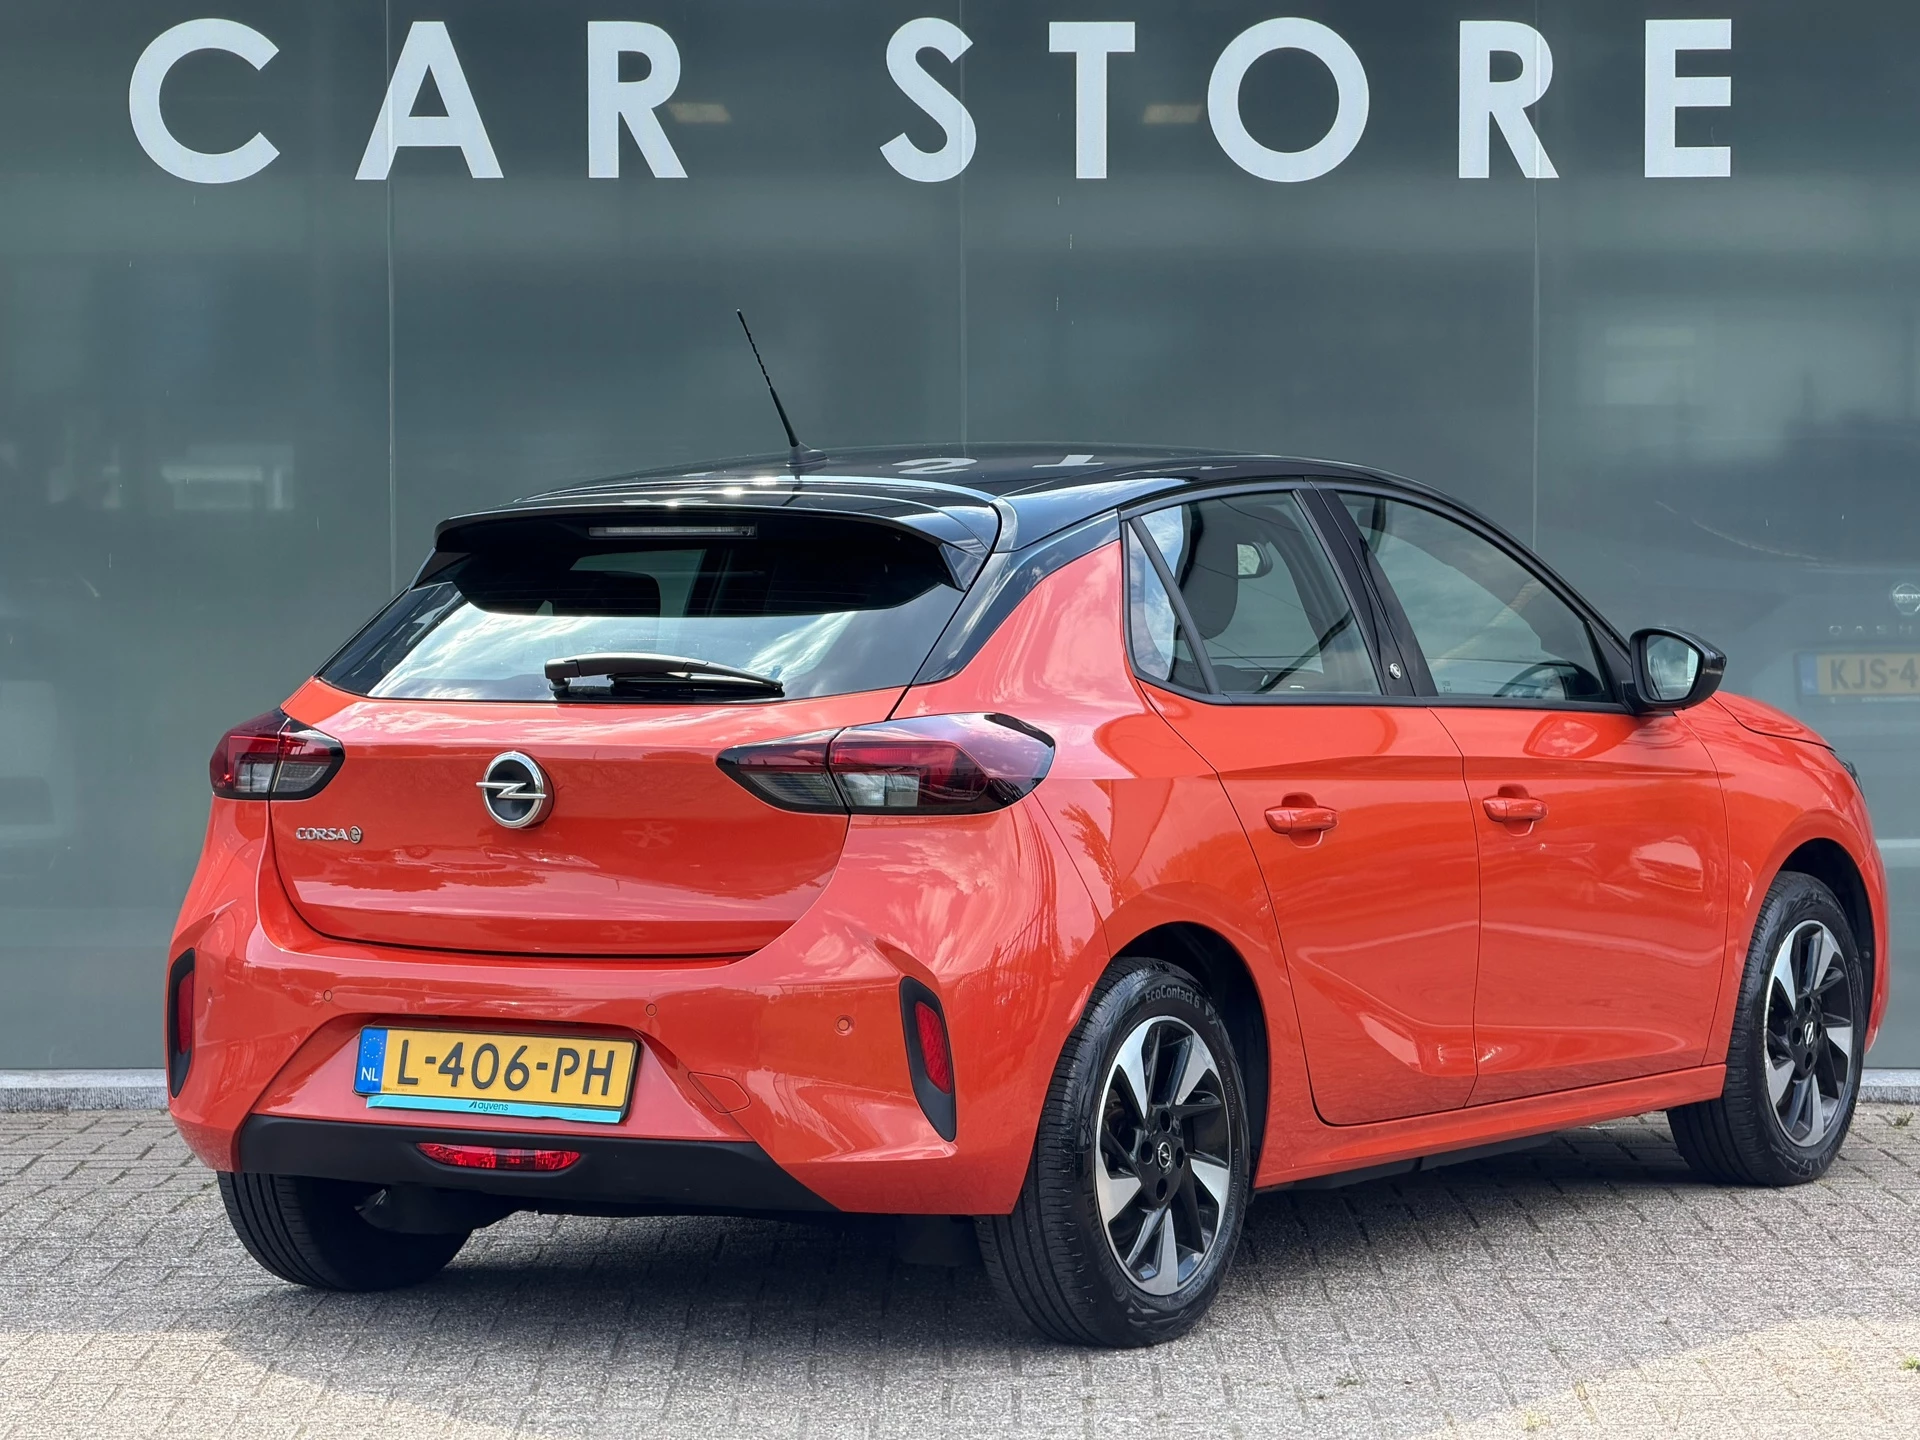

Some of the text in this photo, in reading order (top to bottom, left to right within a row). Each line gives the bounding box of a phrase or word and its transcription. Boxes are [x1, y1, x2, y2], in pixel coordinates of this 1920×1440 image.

[129, 16, 1732, 184] CAR STORE
[295, 827, 348, 842] CORSA
[1145, 984, 1200, 1009] EcoContact 6
[360, 1066, 379, 1082] NL
[397, 1039, 615, 1096] L-406-PH
[475, 1101, 509, 1113] ayvens
